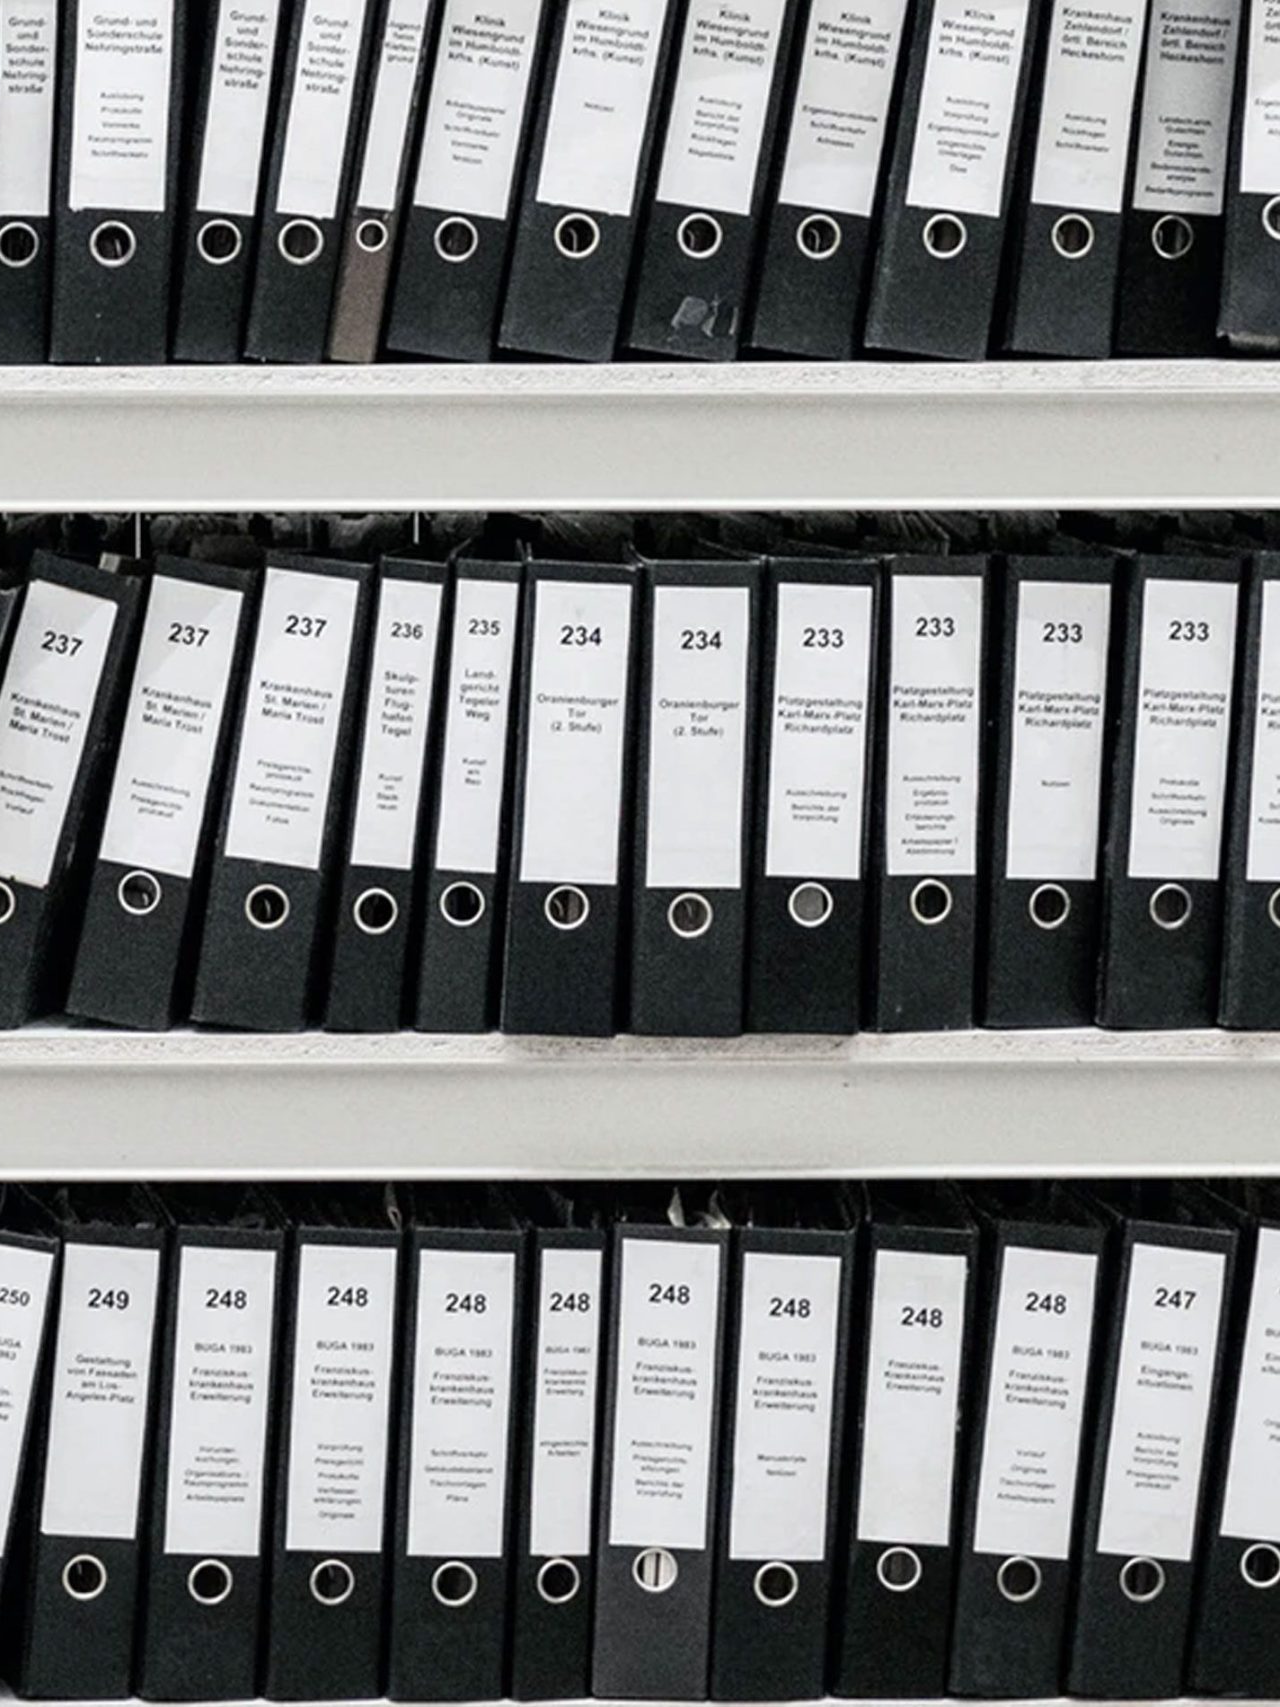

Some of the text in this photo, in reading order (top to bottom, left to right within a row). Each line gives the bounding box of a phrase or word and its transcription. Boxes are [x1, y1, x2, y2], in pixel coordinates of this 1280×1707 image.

[451, 24, 525, 44] Wiesengrund
[167, 621, 210, 647] 237
[284, 613, 328, 638] 237
[390, 621, 423, 640] 236
[468, 617, 501, 636] 235
[559, 624, 602, 647] 234
[914, 616, 955, 638] 233
[1041, 621, 1083, 644] 233
[1168, 619, 1210, 642] 233
[40, 629, 84, 657] 237
[680, 629, 723, 650] 234
[802, 626, 844, 649] 233
[10, 692, 81, 719] Krankenhaus
[536, 692, 619, 708] Oranienburger
[778, 695, 862, 709] Platzgestaltung
[568, 707, 586, 717] Tor
[783, 722, 854, 735] Richardplatz
[87, 1287, 130, 1311] 249
[204, 1287, 247, 1310] 248
[326, 1285, 369, 1308] 248
[444, 1292, 487, 1314] 248
[549, 1291, 590, 1313] 248
[647, 1282, 690, 1306] 248
[1024, 1291, 1067, 1315] 248
[1153, 1286, 1197, 1310] 247
[768, 1296, 811, 1319] 248
[900, 1305, 943, 1329] 248
[194, 1342, 226, 1353] BUGA
[1140, 1340, 1172, 1352] BUGA
[75, 1353, 131, 1369] Gestaltung
